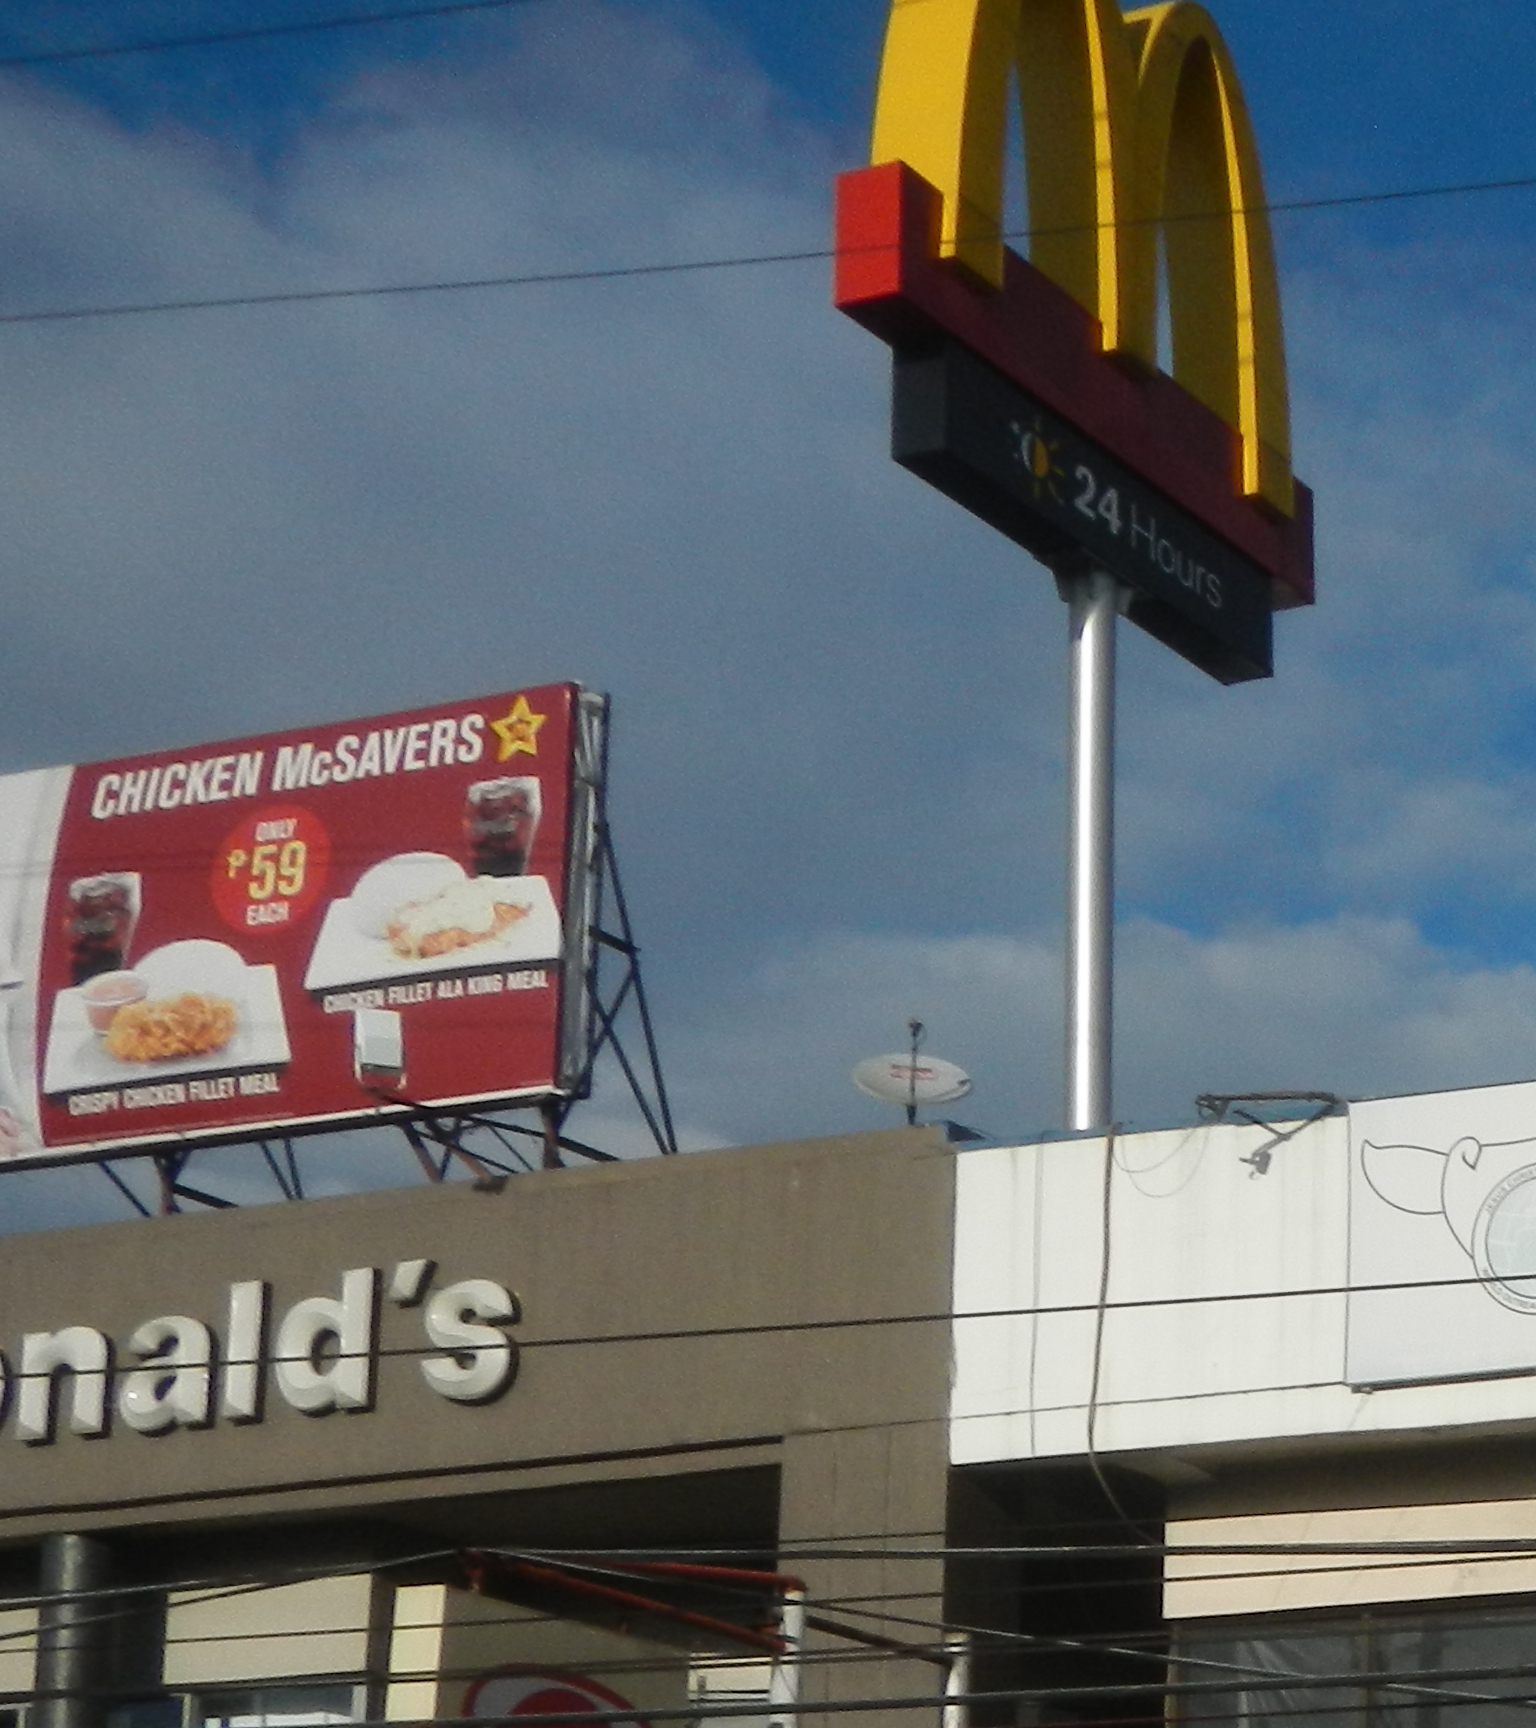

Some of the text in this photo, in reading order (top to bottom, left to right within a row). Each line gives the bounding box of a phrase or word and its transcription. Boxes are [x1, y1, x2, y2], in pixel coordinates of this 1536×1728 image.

[1074, 465, 1222, 608] 24 Hours
[91, 713, 486, 820] CHICKEN McSAVERS
[255, 818, 297, 841] ONLY
[246, 901, 289, 925] EACH
[387, 982, 433, 1005] FILLET
[467, 973, 503, 995] KING
[507, 969, 549, 991] MEAL
[189, 1076, 236, 1101] FILLET
[239, 1072, 280, 1096] MEAL
[0, 1258, 517, 1442] nald's
